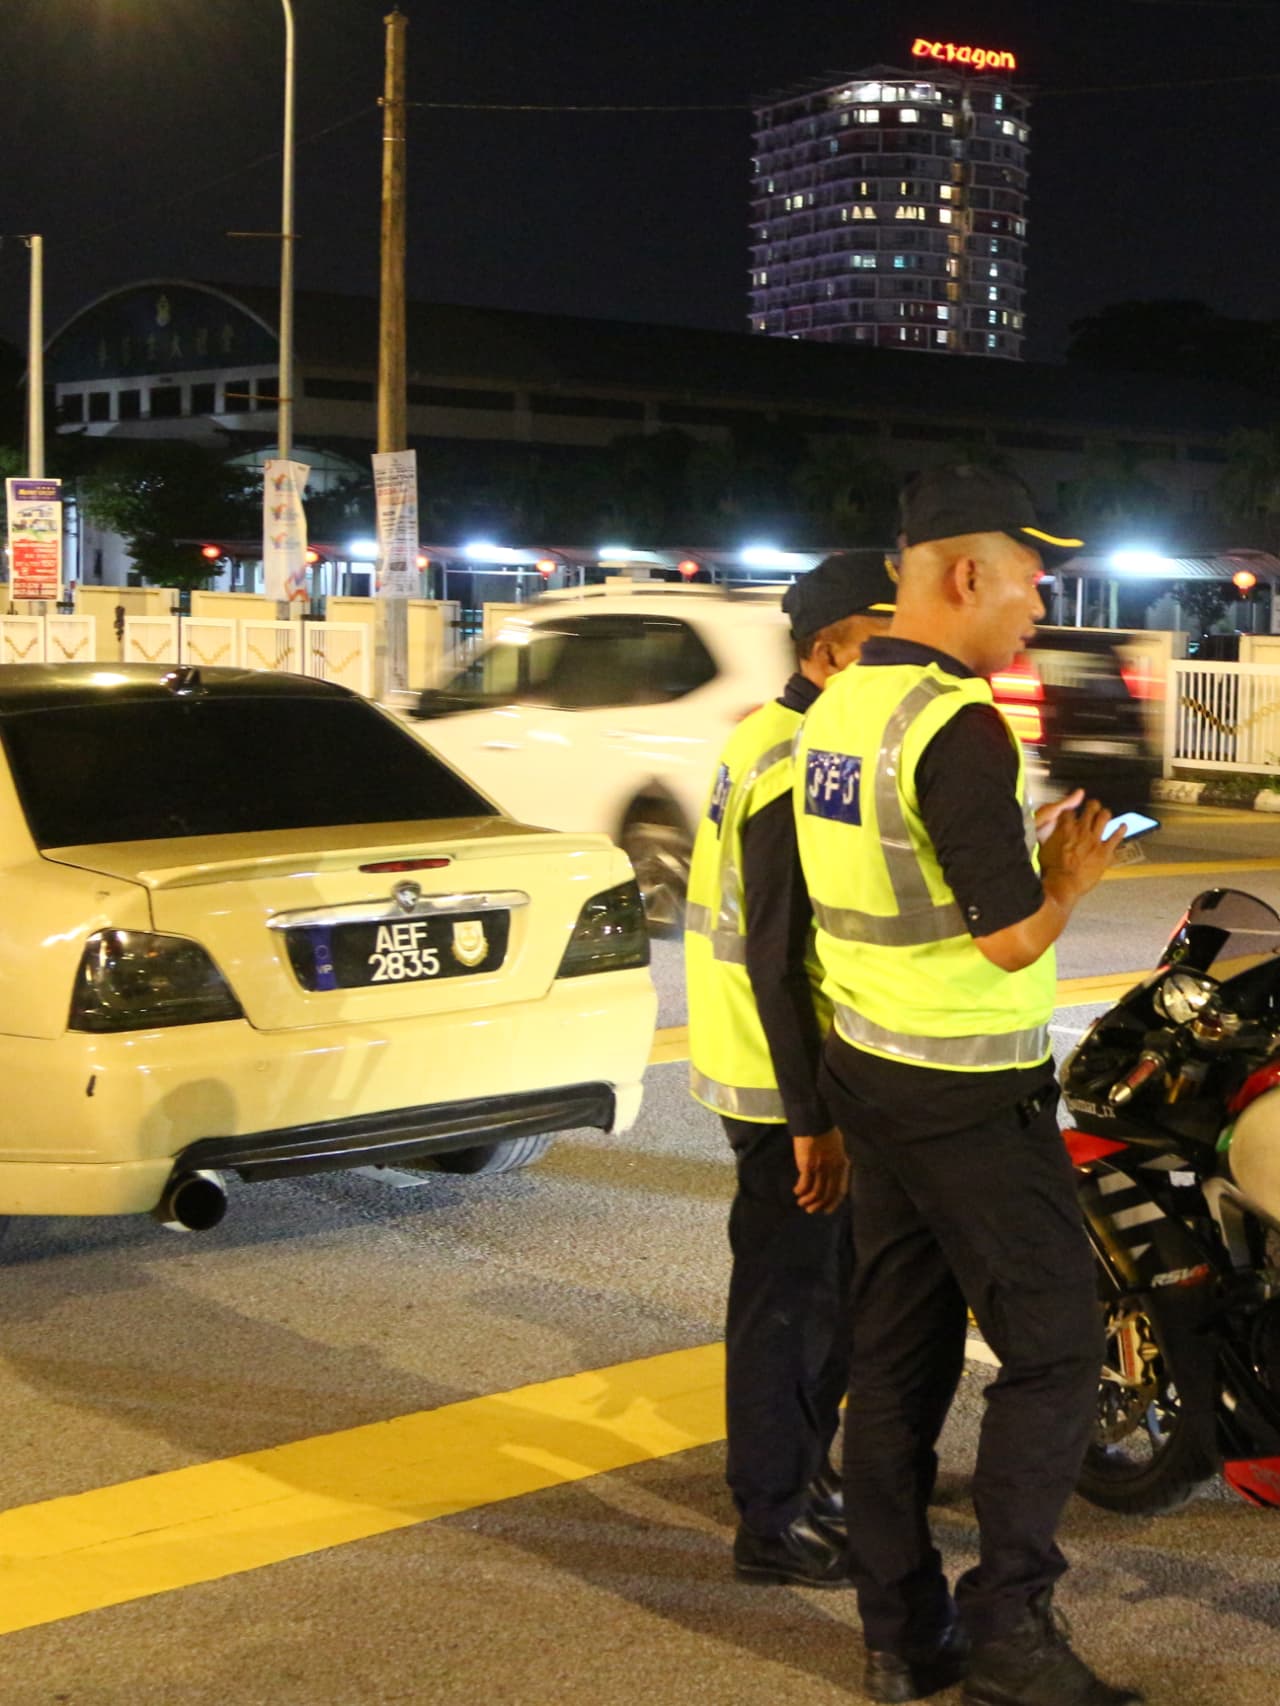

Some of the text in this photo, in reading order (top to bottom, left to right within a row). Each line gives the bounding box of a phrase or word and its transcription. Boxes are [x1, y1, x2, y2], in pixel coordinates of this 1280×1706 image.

[912, 38, 1016, 70] Octagon
[376, 922, 428, 953] AEF
[368, 948, 440, 982] 2835
